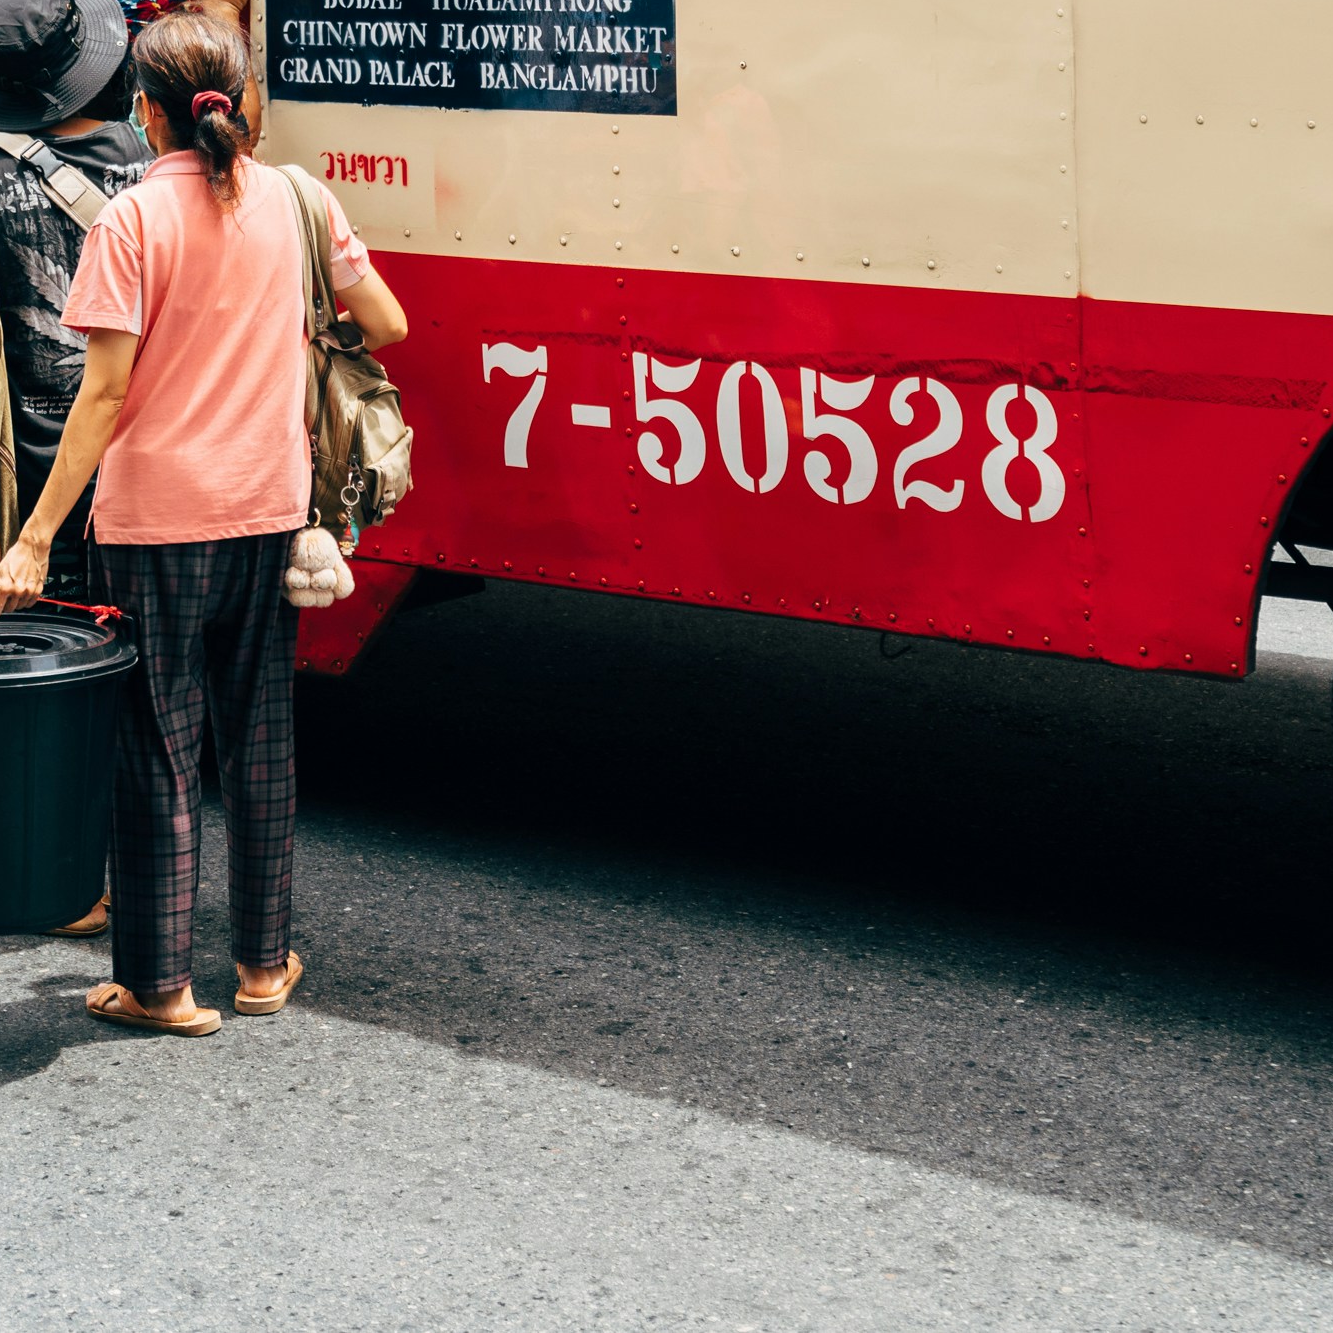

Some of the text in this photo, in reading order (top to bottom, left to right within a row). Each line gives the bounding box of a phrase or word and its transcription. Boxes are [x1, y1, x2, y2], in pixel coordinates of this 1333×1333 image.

[282, 19, 667, 54] CHINATOWN FLOWER MARKET
[279, 57, 659, 95] GRAND PALACE BANGLAMPHU
[482, 342, 1067, 524] 7-50528
